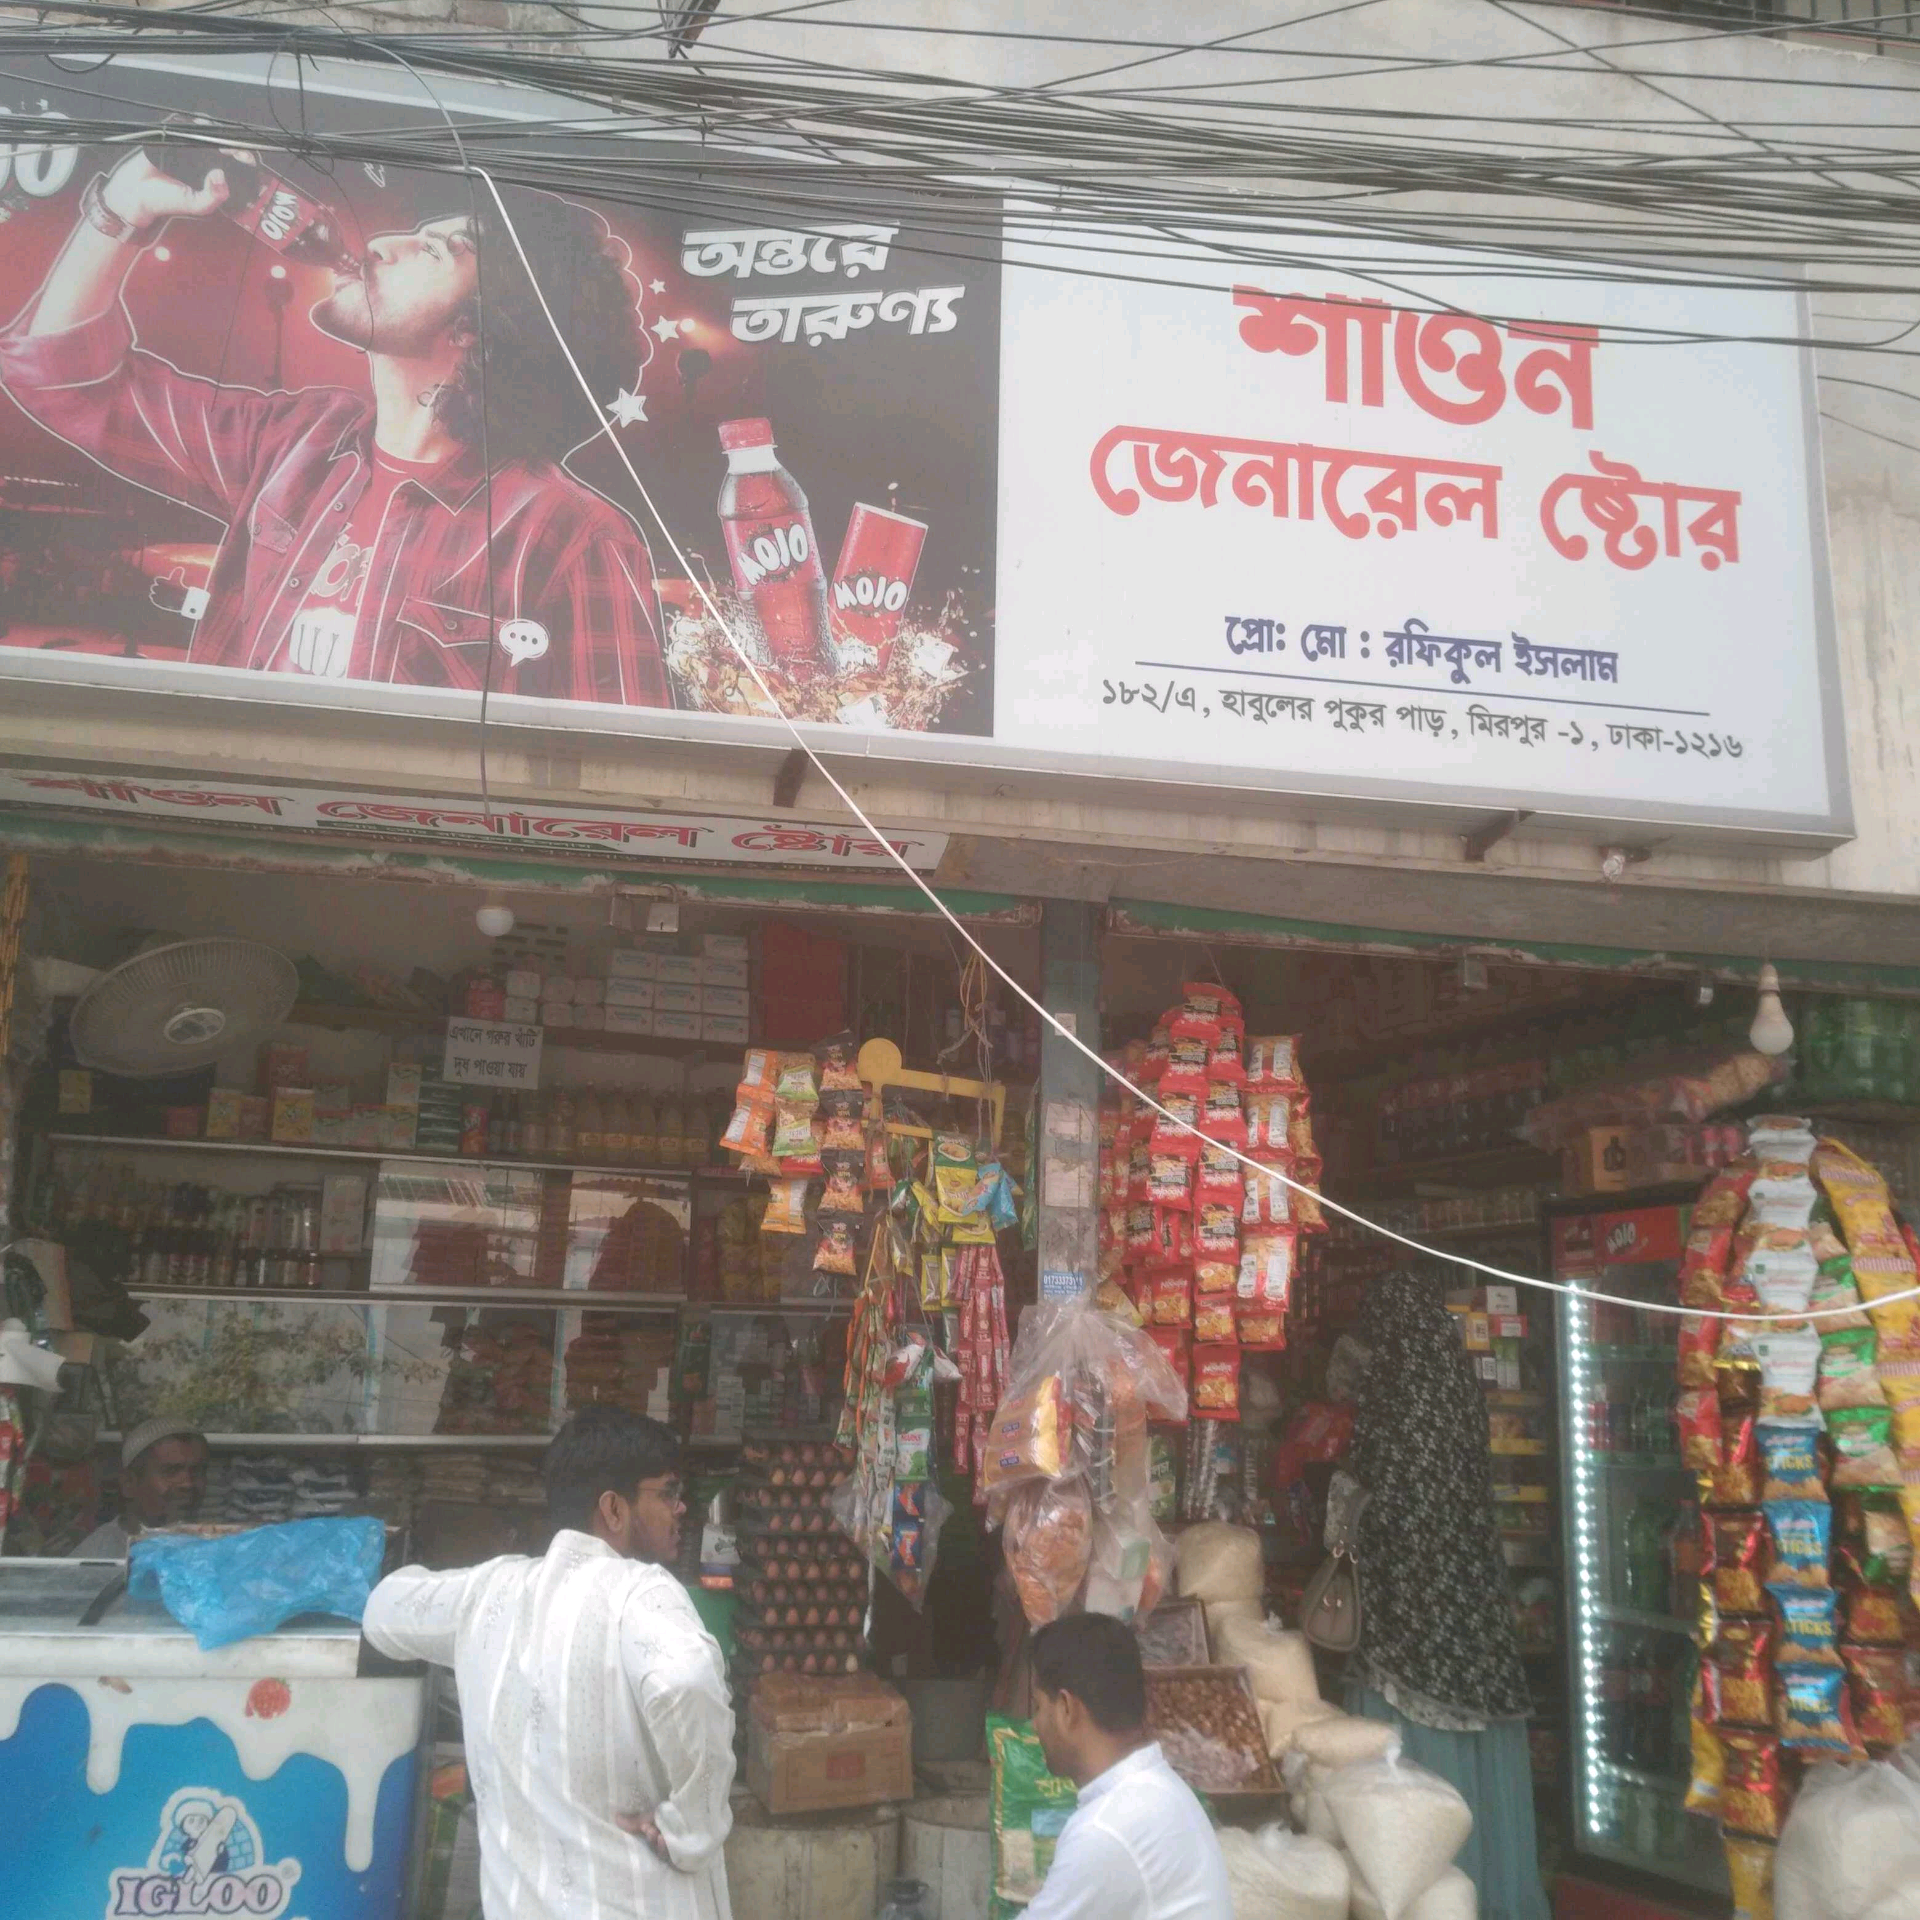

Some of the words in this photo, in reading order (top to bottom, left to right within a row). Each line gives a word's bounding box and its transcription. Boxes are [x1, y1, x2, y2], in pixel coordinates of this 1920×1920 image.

[681, 221, 900, 278] অন্তরে
[730, 284, 966, 347] তারুণ্য
[1232, 283, 1600, 431] শাওন
[1090, 425, 1502, 539] জেনারেল
[833, 576, 907, 611] MOJO
[1383, 618, 1502, 684] রফিকুল
[1511, 631, 1618, 683] ইসলাম
[1218, 689, 1316, 725] হাবুলের
[1323, 698, 1387, 733] পুকুর
[1466, 703, 1547, 748] মিরপুর
[316, 801, 714, 849] জেনারেল
[113, 1873, 284, 1917] IGLOO
